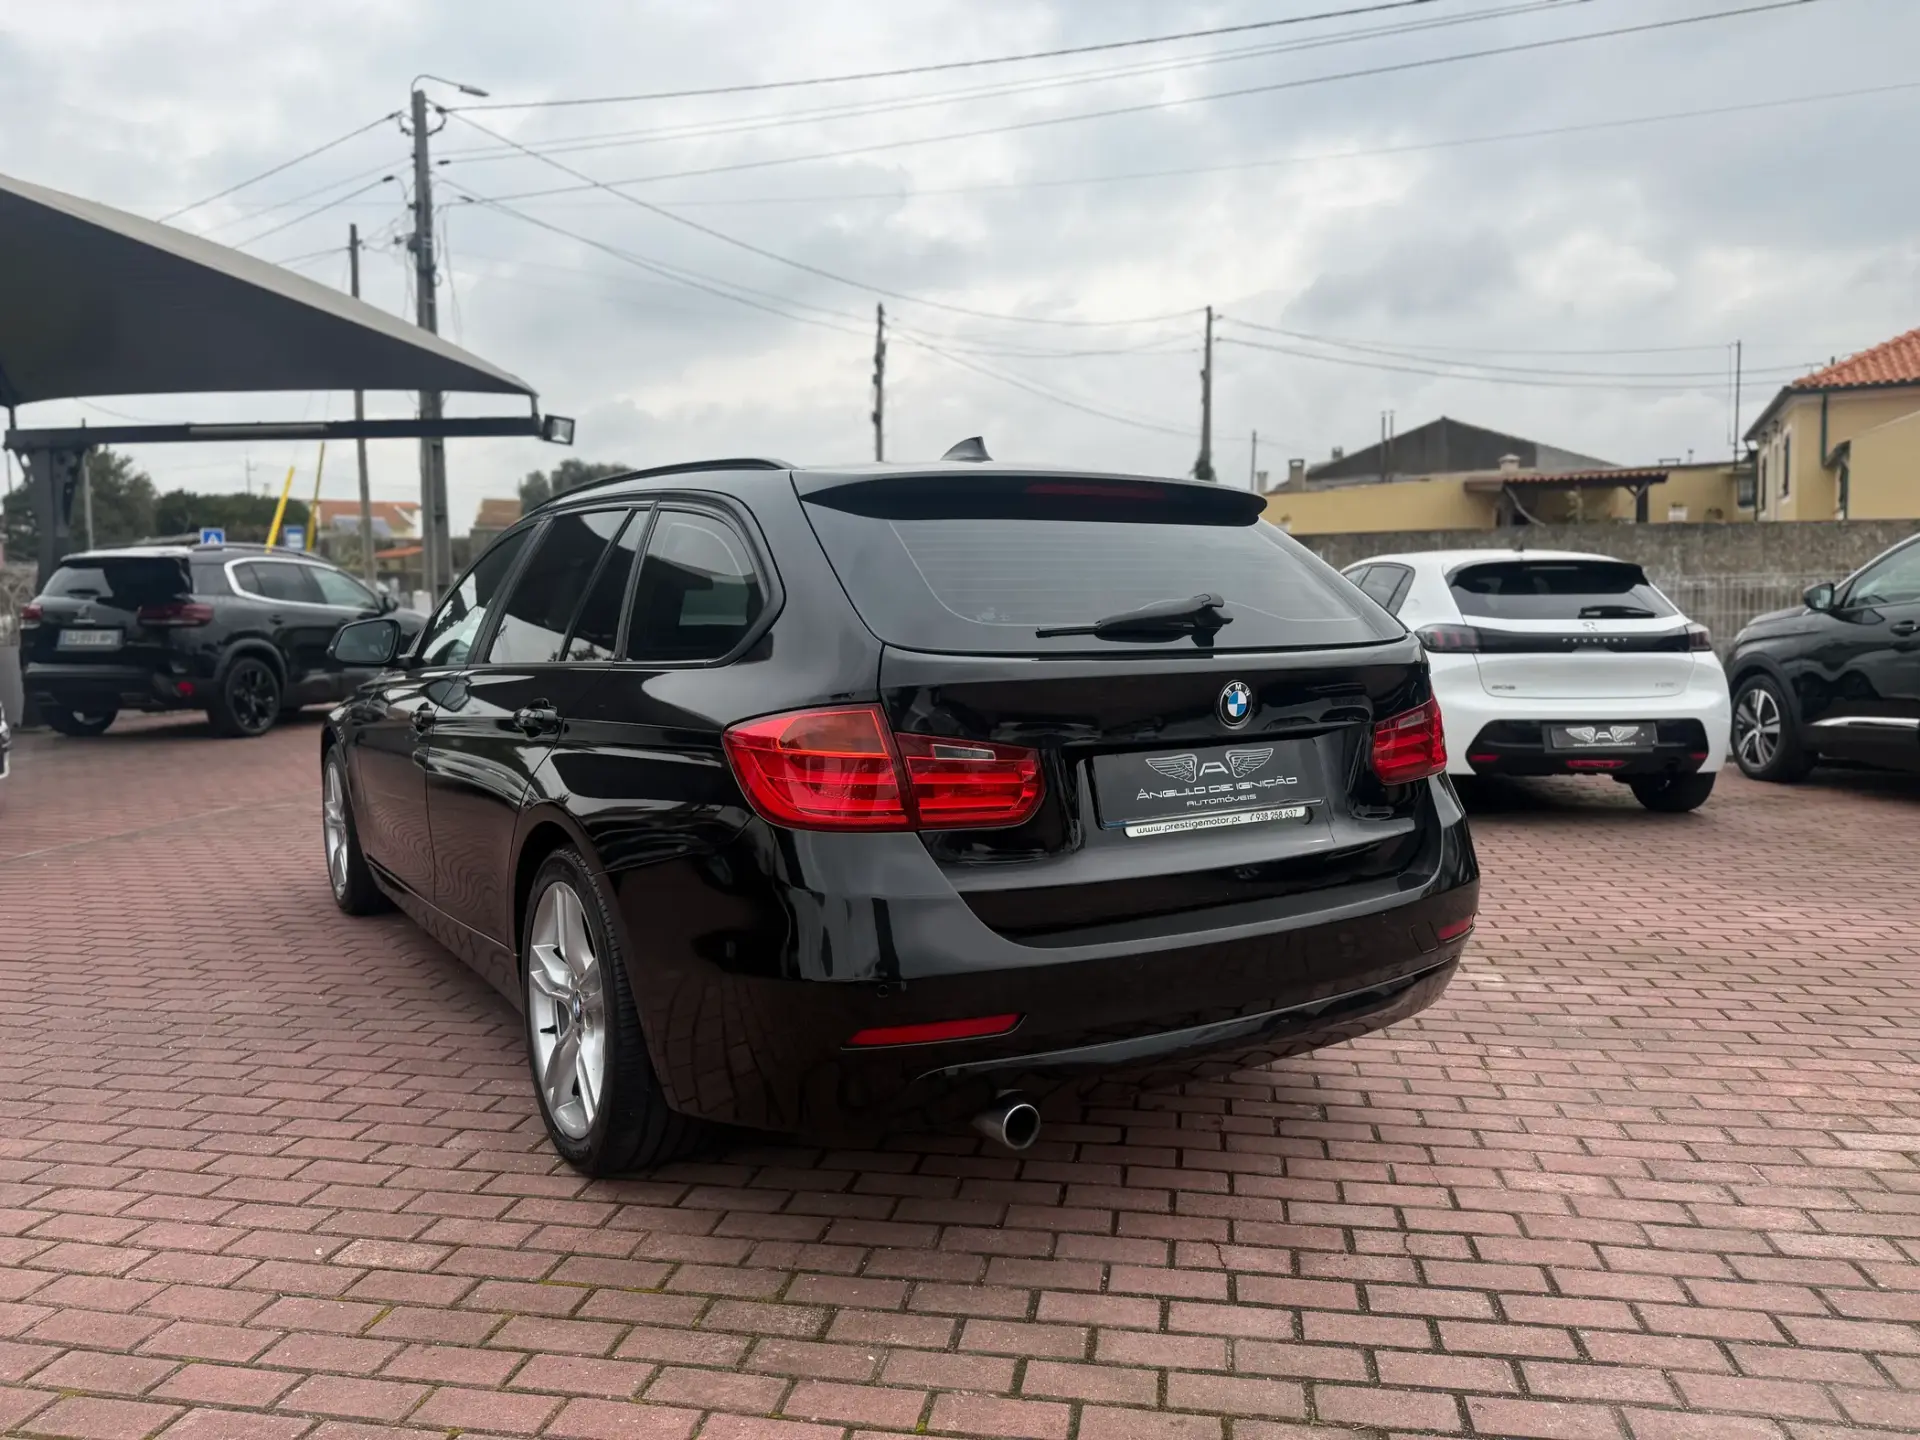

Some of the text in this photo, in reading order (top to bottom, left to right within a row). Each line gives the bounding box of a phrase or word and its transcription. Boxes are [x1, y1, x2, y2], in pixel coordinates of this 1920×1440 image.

[1224, 683, 1251, 697] BMW
[1199, 762, 1229, 776] A
[1136, 776, 1298, 800] ÂNGULO DE IGNIÇÃO
[1186, 794, 1257, 806] AUTOMÓVEIS
[1136, 809, 1298, 834] www.prestigemotor.pt 938 258 637
